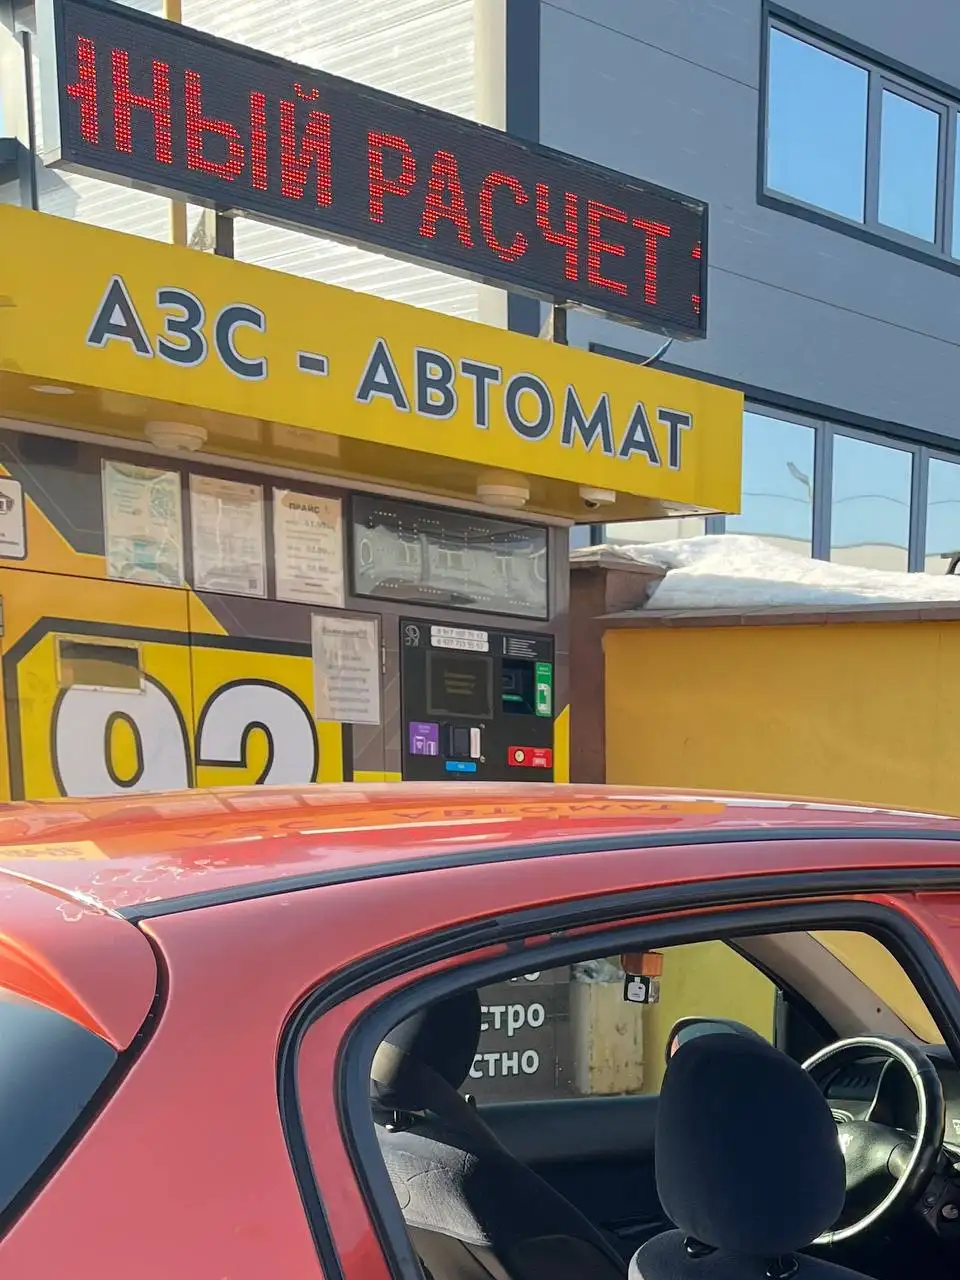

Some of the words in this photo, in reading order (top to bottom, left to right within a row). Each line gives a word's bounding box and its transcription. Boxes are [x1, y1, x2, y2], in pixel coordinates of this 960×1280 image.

[367, 130, 671, 306] РАСЧЕТ
[87, 275, 268, 380] АЗС
[355, 338, 693, 471] АВТОМАТ
